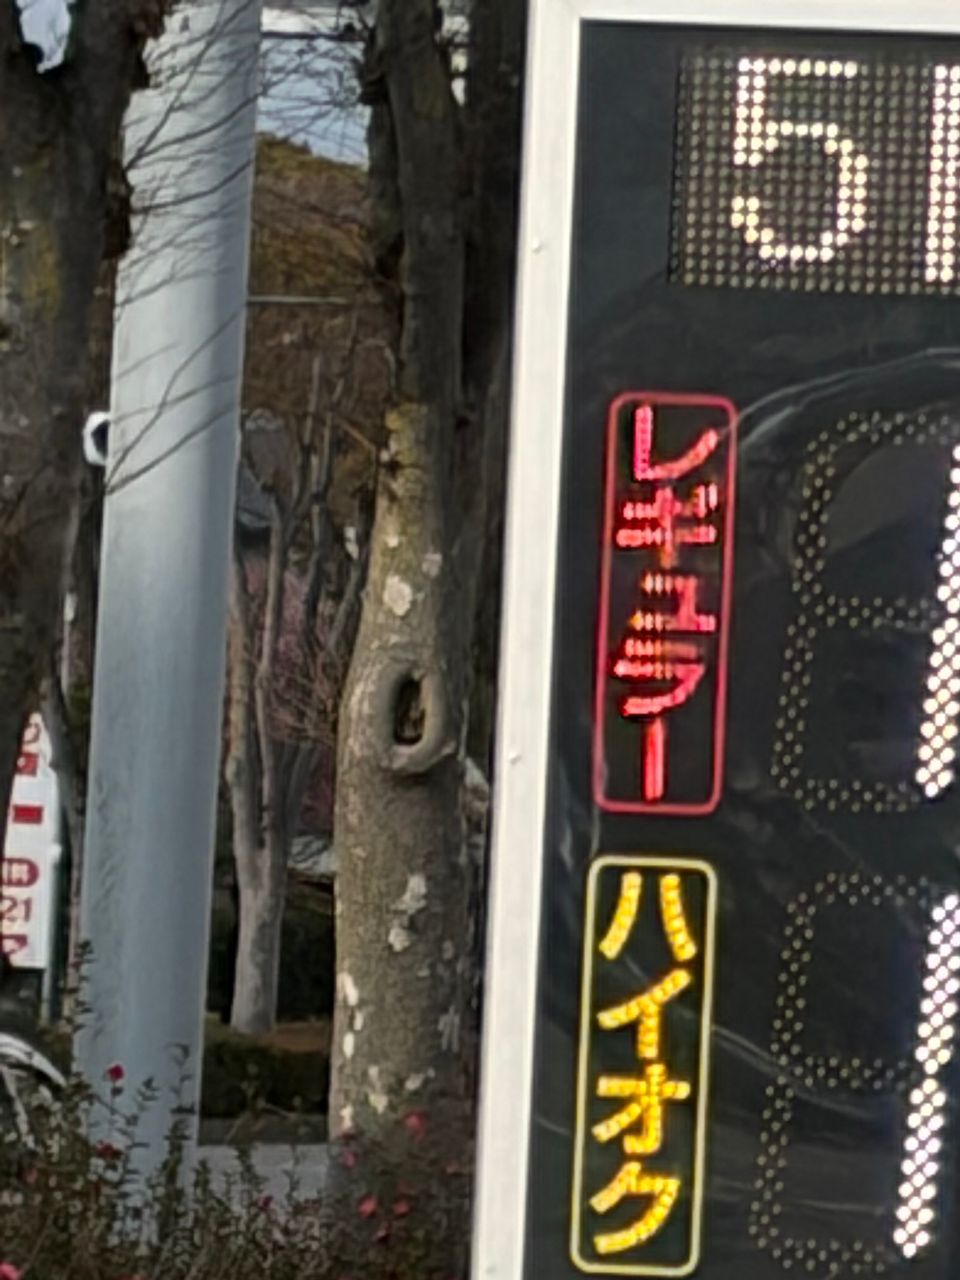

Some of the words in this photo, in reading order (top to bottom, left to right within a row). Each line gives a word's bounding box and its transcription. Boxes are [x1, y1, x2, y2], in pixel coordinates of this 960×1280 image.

[612, 402, 718, 802] レギュラー
[590, 872, 697, 1254] ハイオク
